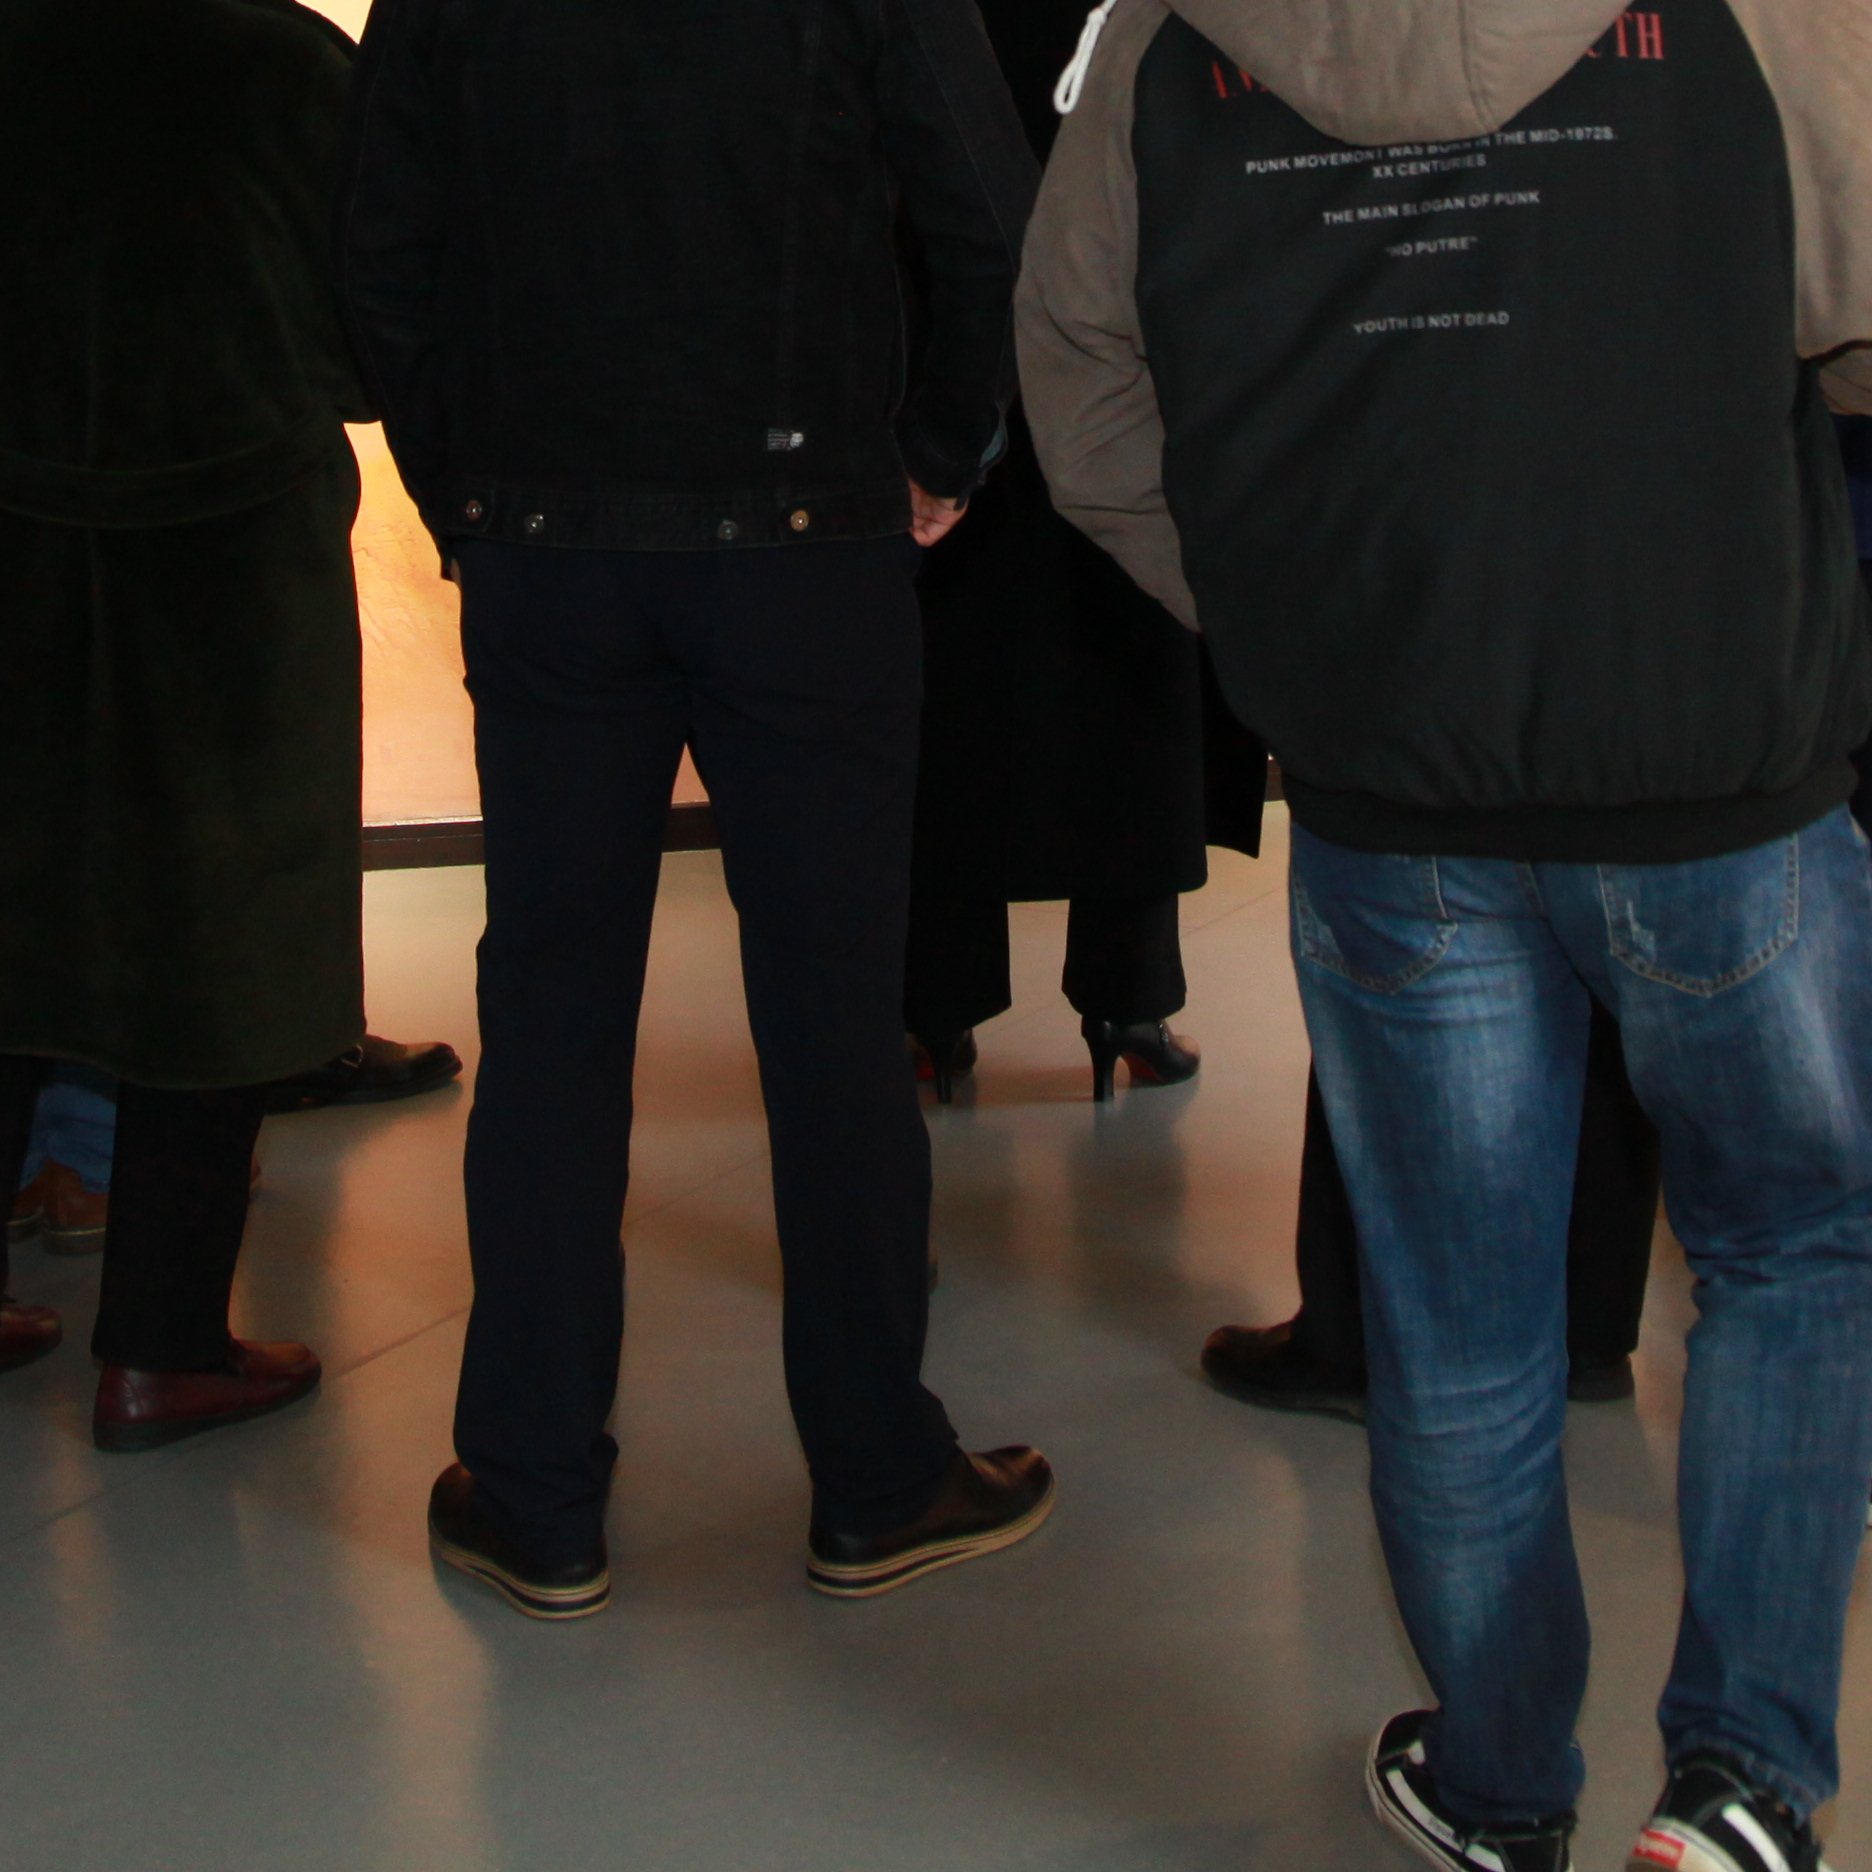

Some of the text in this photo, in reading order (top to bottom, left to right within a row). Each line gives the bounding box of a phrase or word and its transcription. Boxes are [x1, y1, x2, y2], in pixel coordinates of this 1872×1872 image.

[1245, 156, 1291, 175] PUNK
[1494, 131, 1527, 146] THE
[1371, 153, 1487, 179] XX CENTURIES
[1322, 190, 1541, 225] THE MAIN SLOGAN OF PUNK
[1353, 310, 1511, 335] YOUTH IS NOT DEAD
